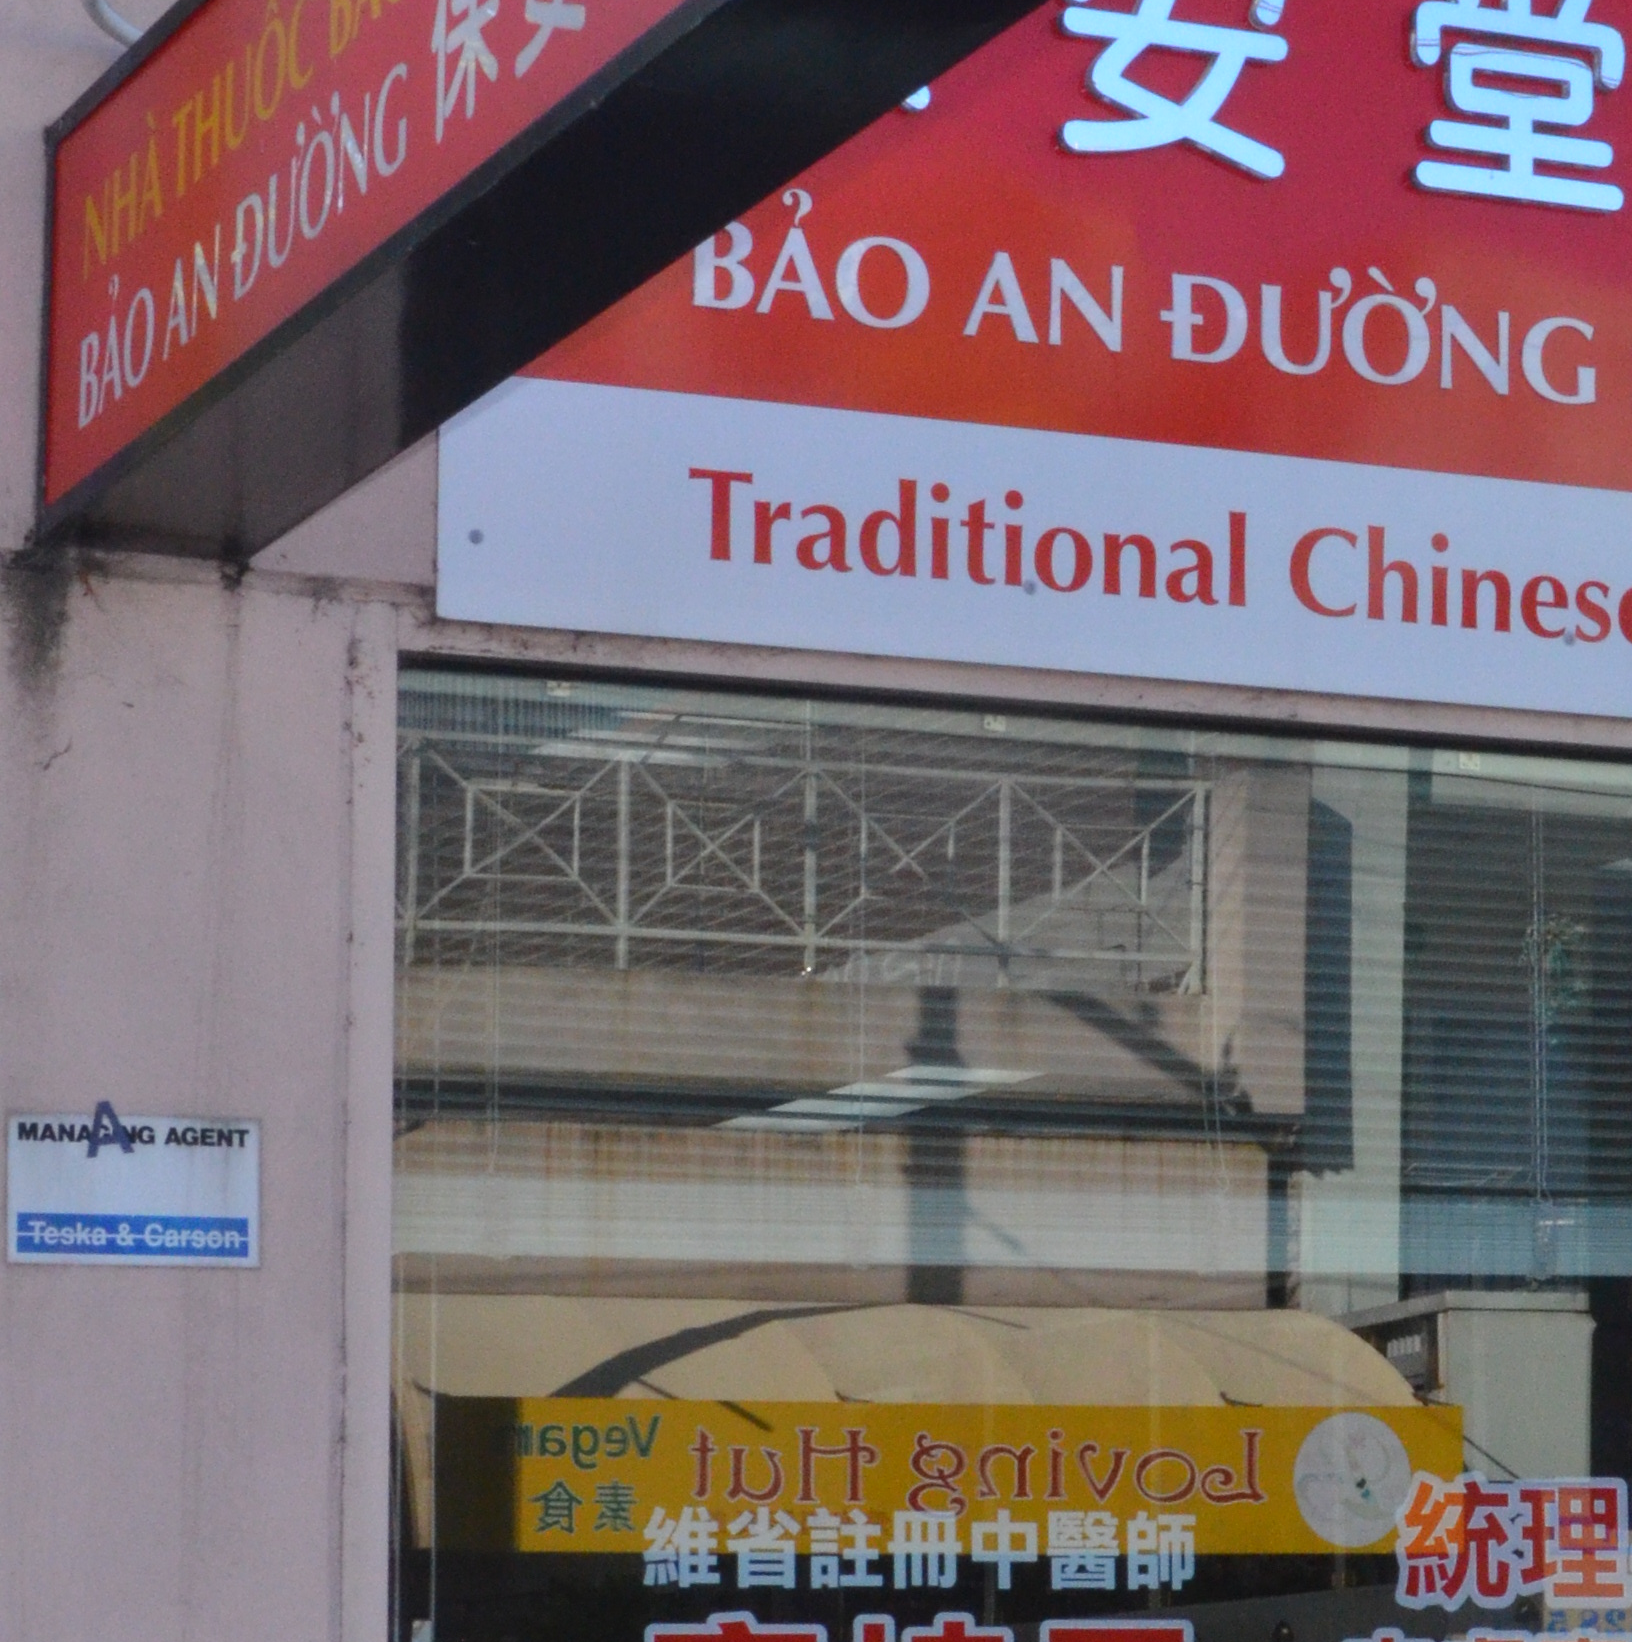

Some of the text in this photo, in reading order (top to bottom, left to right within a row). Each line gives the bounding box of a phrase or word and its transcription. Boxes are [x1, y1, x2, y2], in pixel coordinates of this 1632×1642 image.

[78, 62, 408, 430] BẢO AN ĐƯỜNG
[83, 111, 162, 281] NHÀ
[692, 190, 930, 330] BẢO
[963, 252, 1124, 353] AN
[1160, 266, 1597, 406] ĐƯỜNG
[688, 466, 1248, 609] Traditional
[17, 1121, 250, 1148] MANAGNG AGENT
[28, 1220, 107, 1246] Teska
[116, 1223, 135, 1246] &
[641, 1506, 1198, 1592] 維省註冊中醫師
